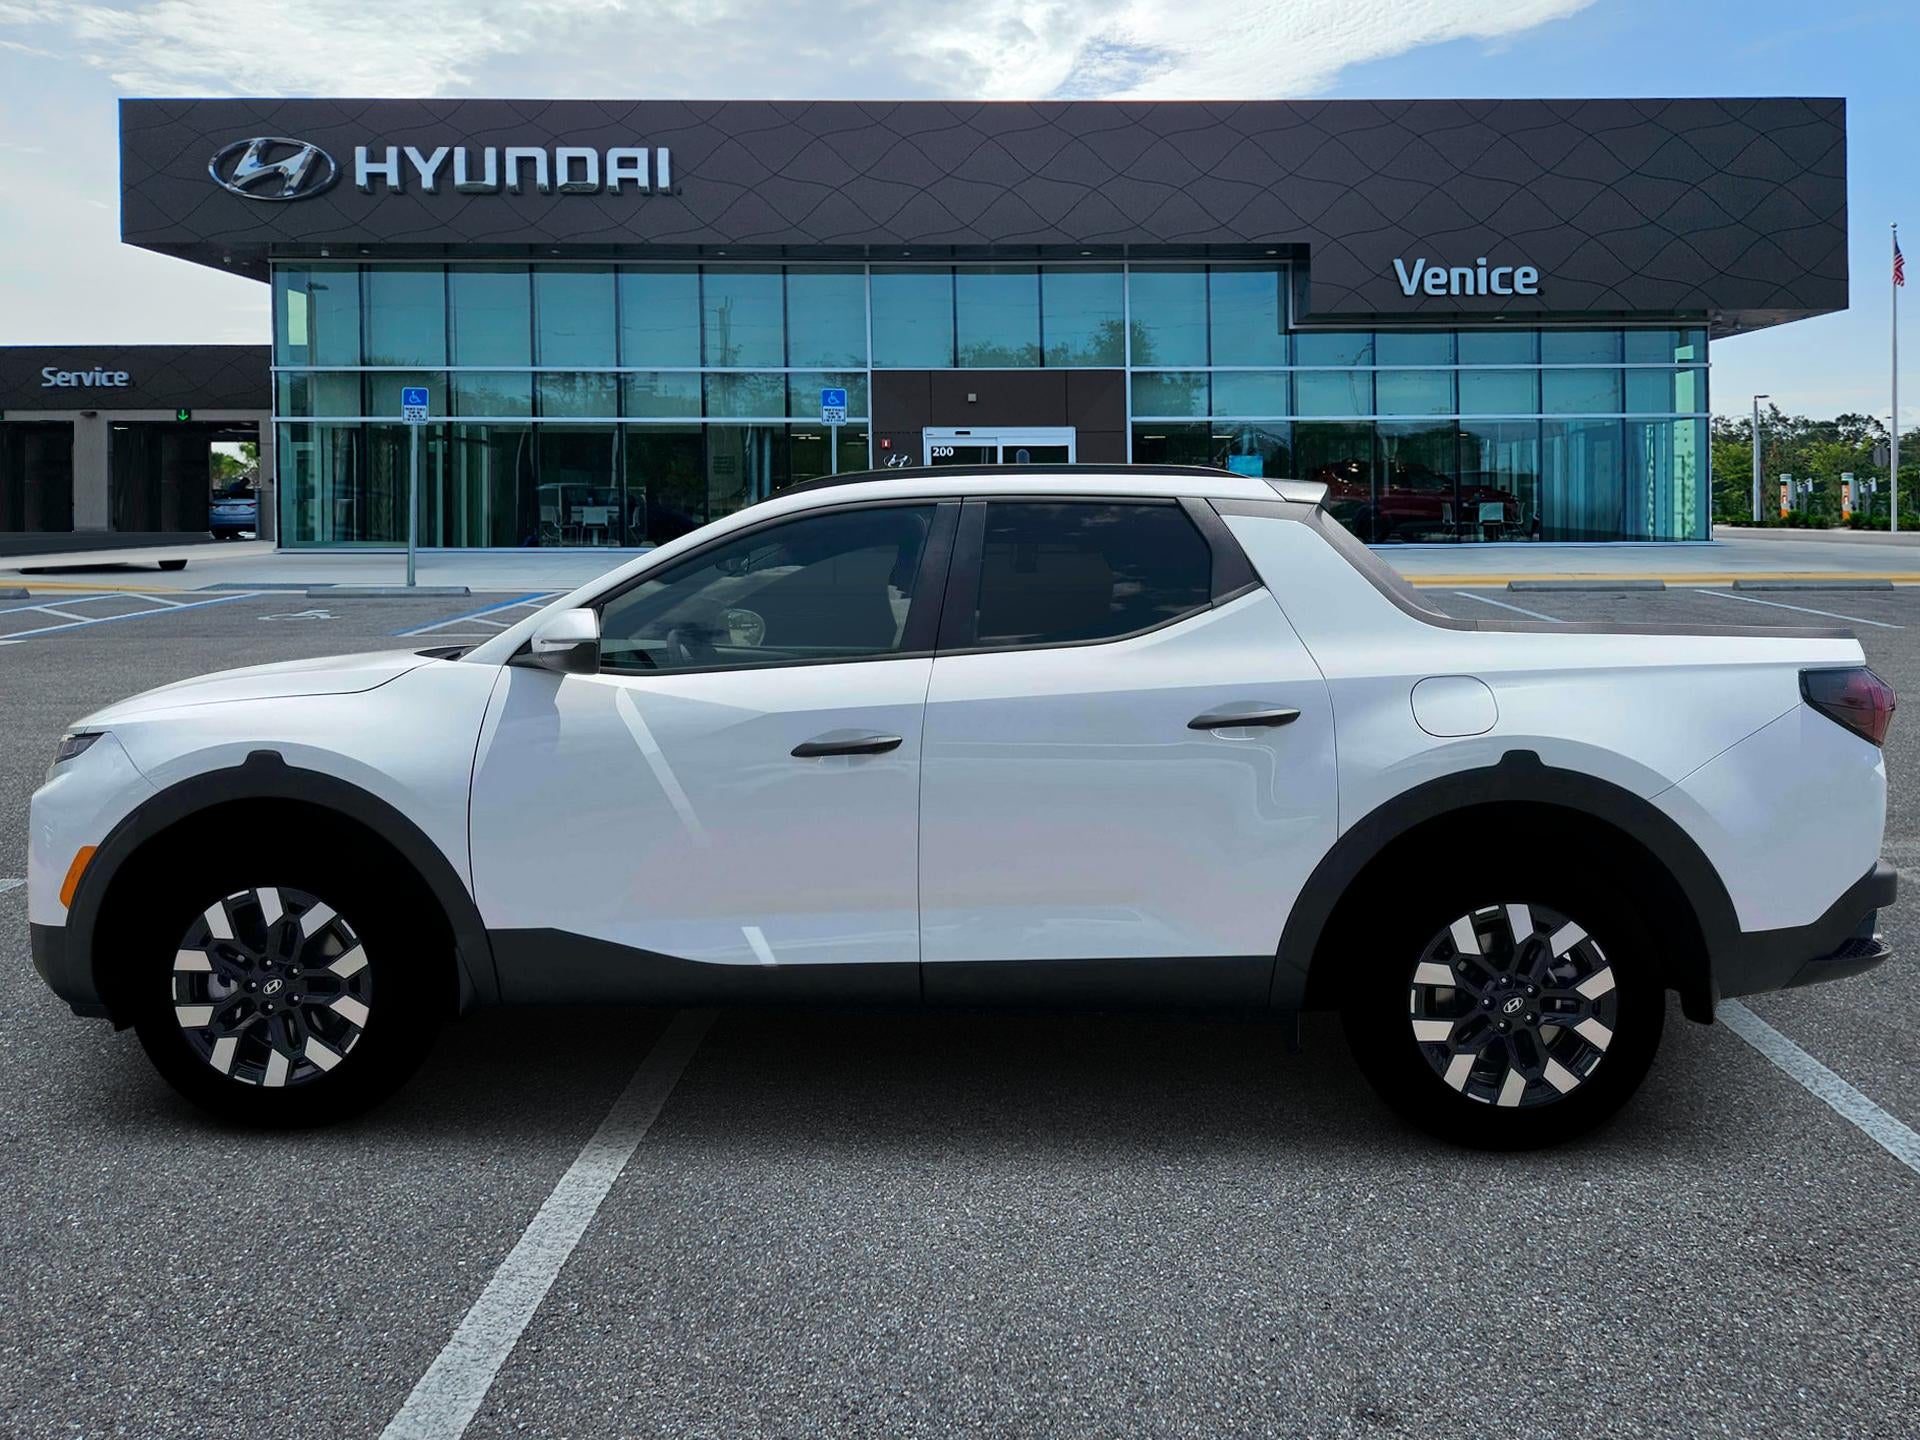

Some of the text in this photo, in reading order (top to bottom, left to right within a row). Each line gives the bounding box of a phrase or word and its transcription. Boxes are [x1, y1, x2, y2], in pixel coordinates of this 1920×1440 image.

[354, 146, 672, 194] HYUNDAI
[1393, 257, 1539, 296] Venice
[41, 366, 129, 387] Service
[932, 446, 954, 457] 200
